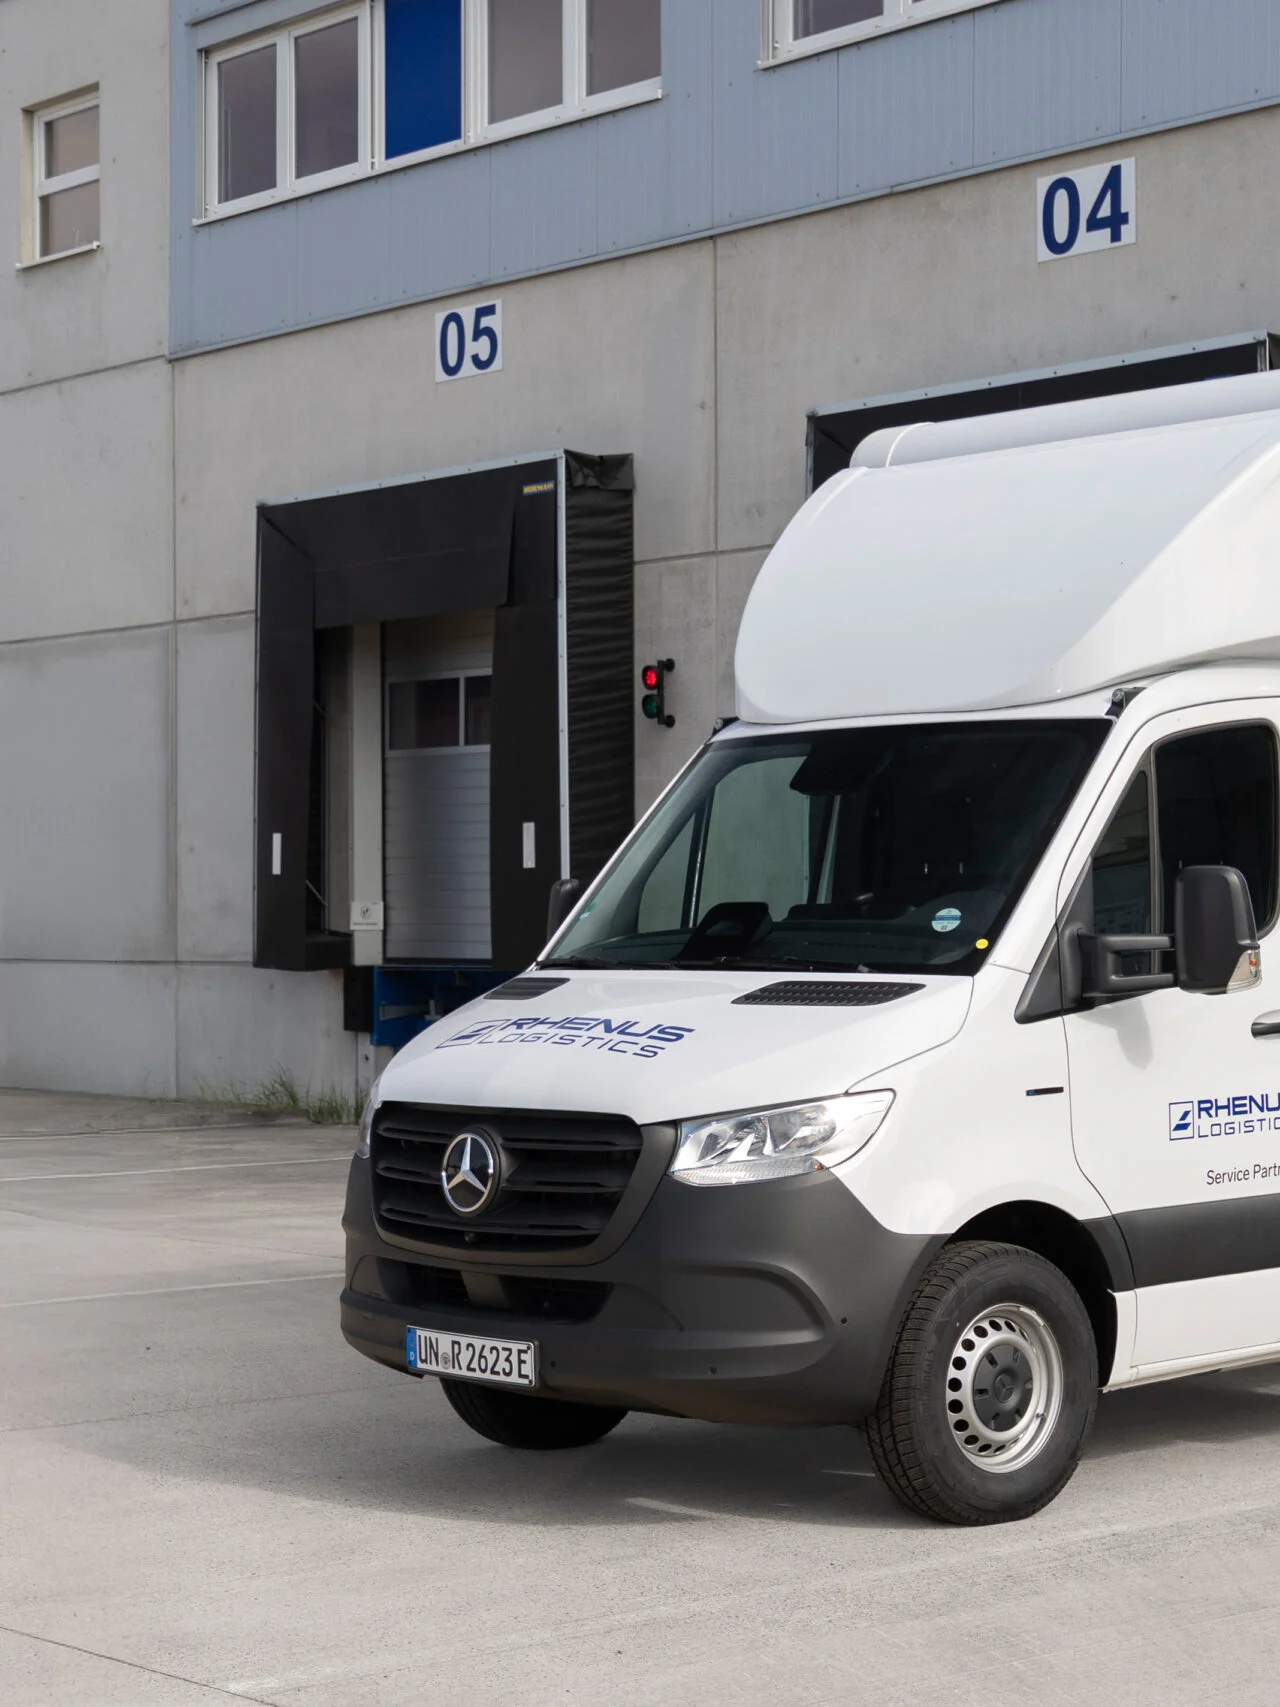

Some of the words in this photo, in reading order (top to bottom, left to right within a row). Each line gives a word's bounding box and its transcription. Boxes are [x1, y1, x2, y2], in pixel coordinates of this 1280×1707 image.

[1042, 163, 1130, 256] 04
[440, 303, 498, 377] 05
[500, 1016, 695, 1043] RHENUS
[477, 1032, 666, 1058] LOGISTICS
[1206, 1167, 1250, 1186] Service
[418, 1334, 439, 1367] UN
